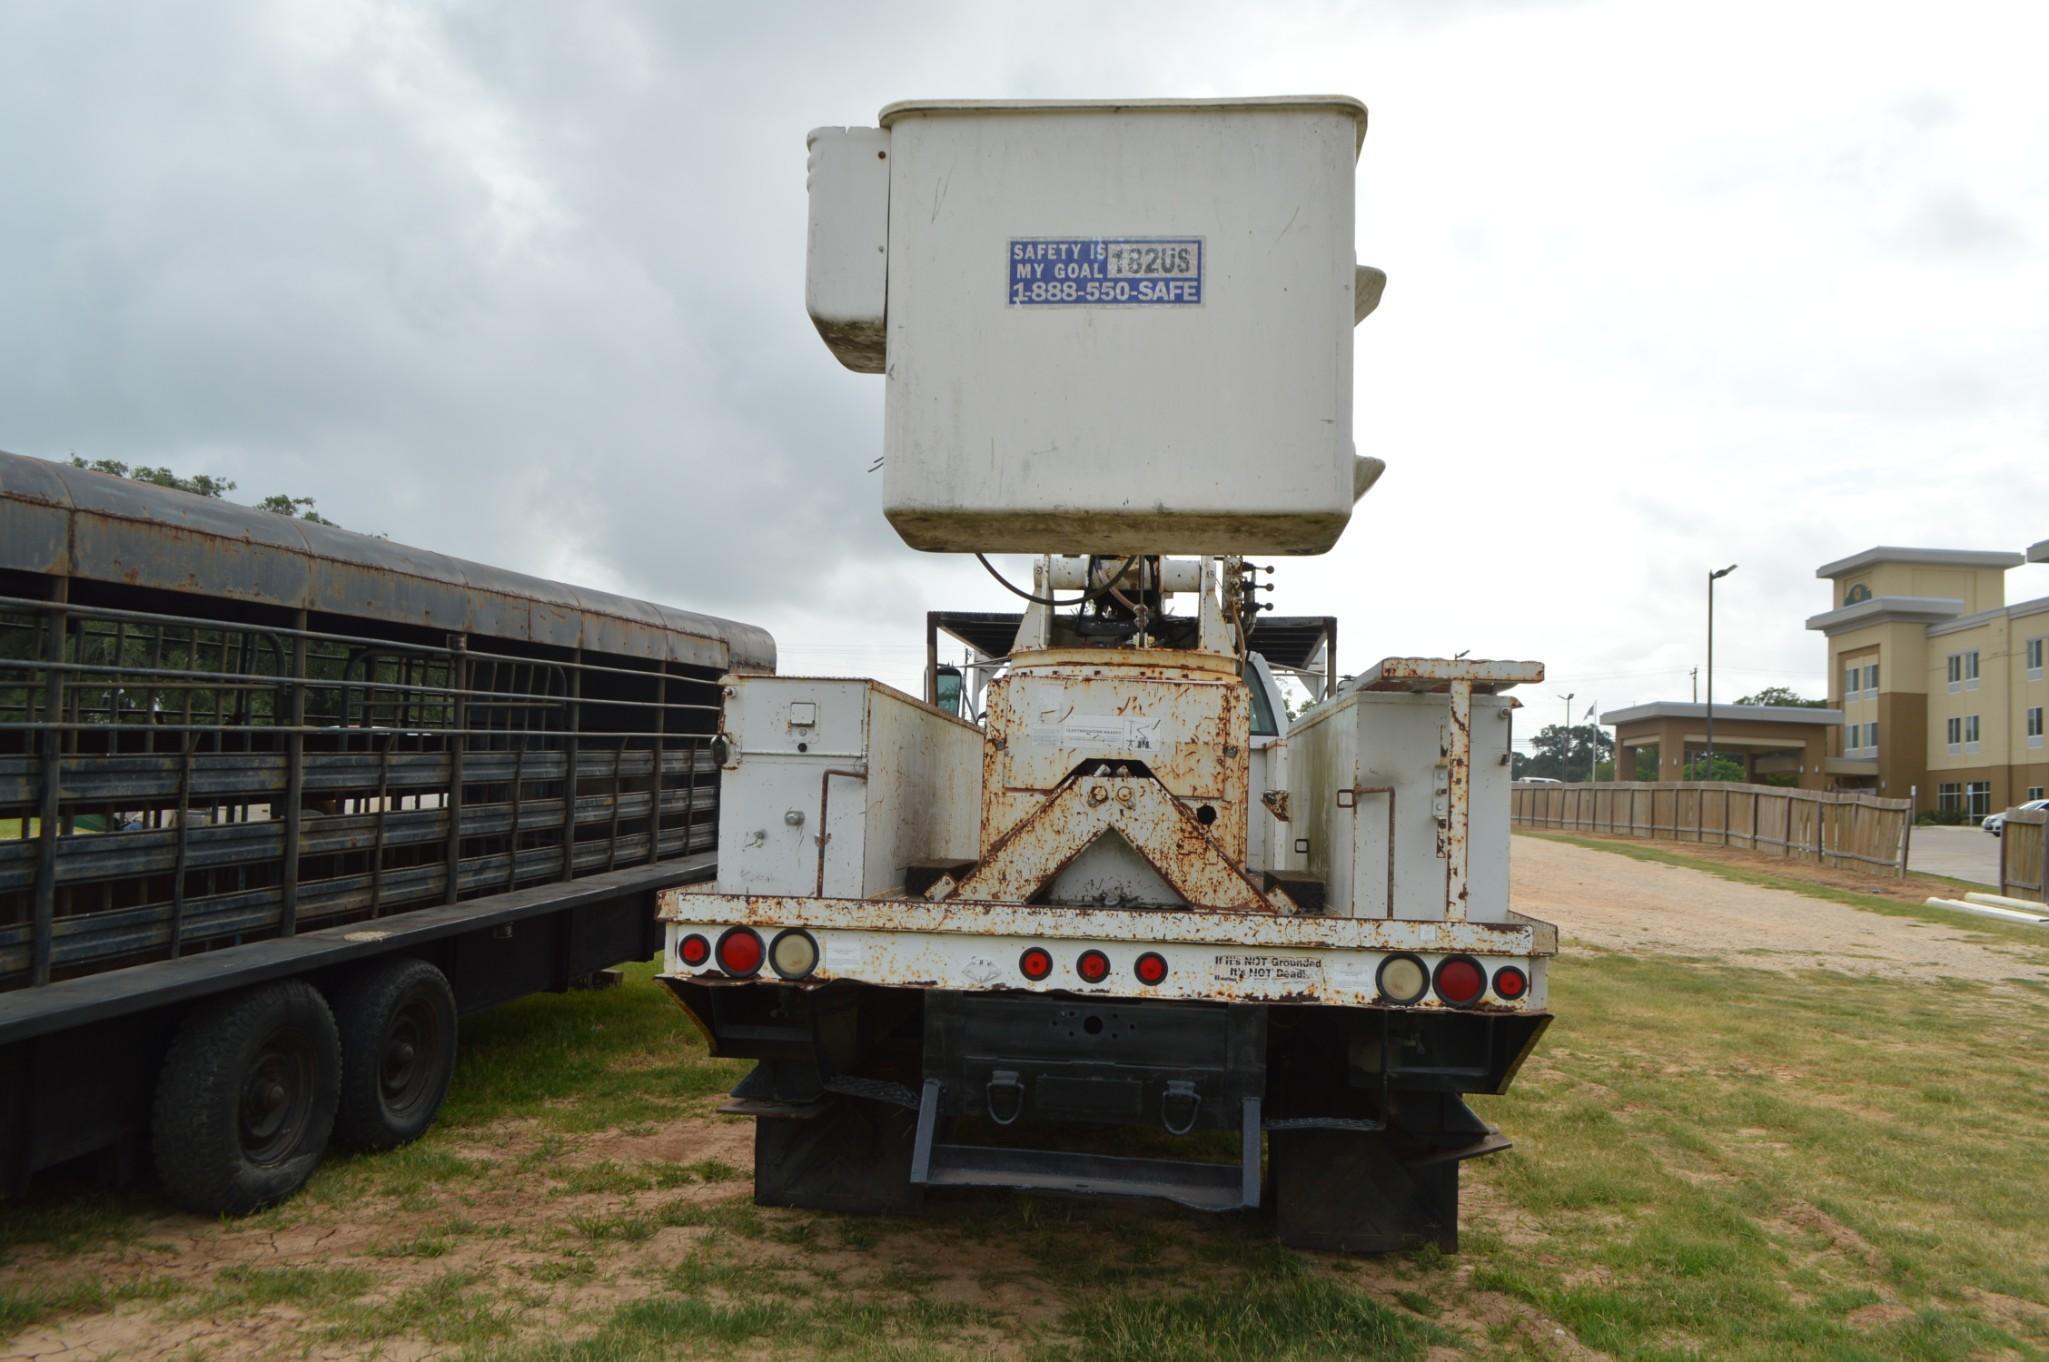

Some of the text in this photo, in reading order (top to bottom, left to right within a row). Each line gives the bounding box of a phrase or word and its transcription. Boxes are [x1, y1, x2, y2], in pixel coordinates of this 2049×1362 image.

[1014, 244, 1107, 259] SAFETY IS
[1016, 263, 1103, 279] MY GOAL
[1013, 281, 1198, 301] 1-888-550-SAFE
[1244, 956, 1268, 966] NOT
[1272, 958, 1321, 968] Grounded
[1249, 968, 1271, 977] NOT
